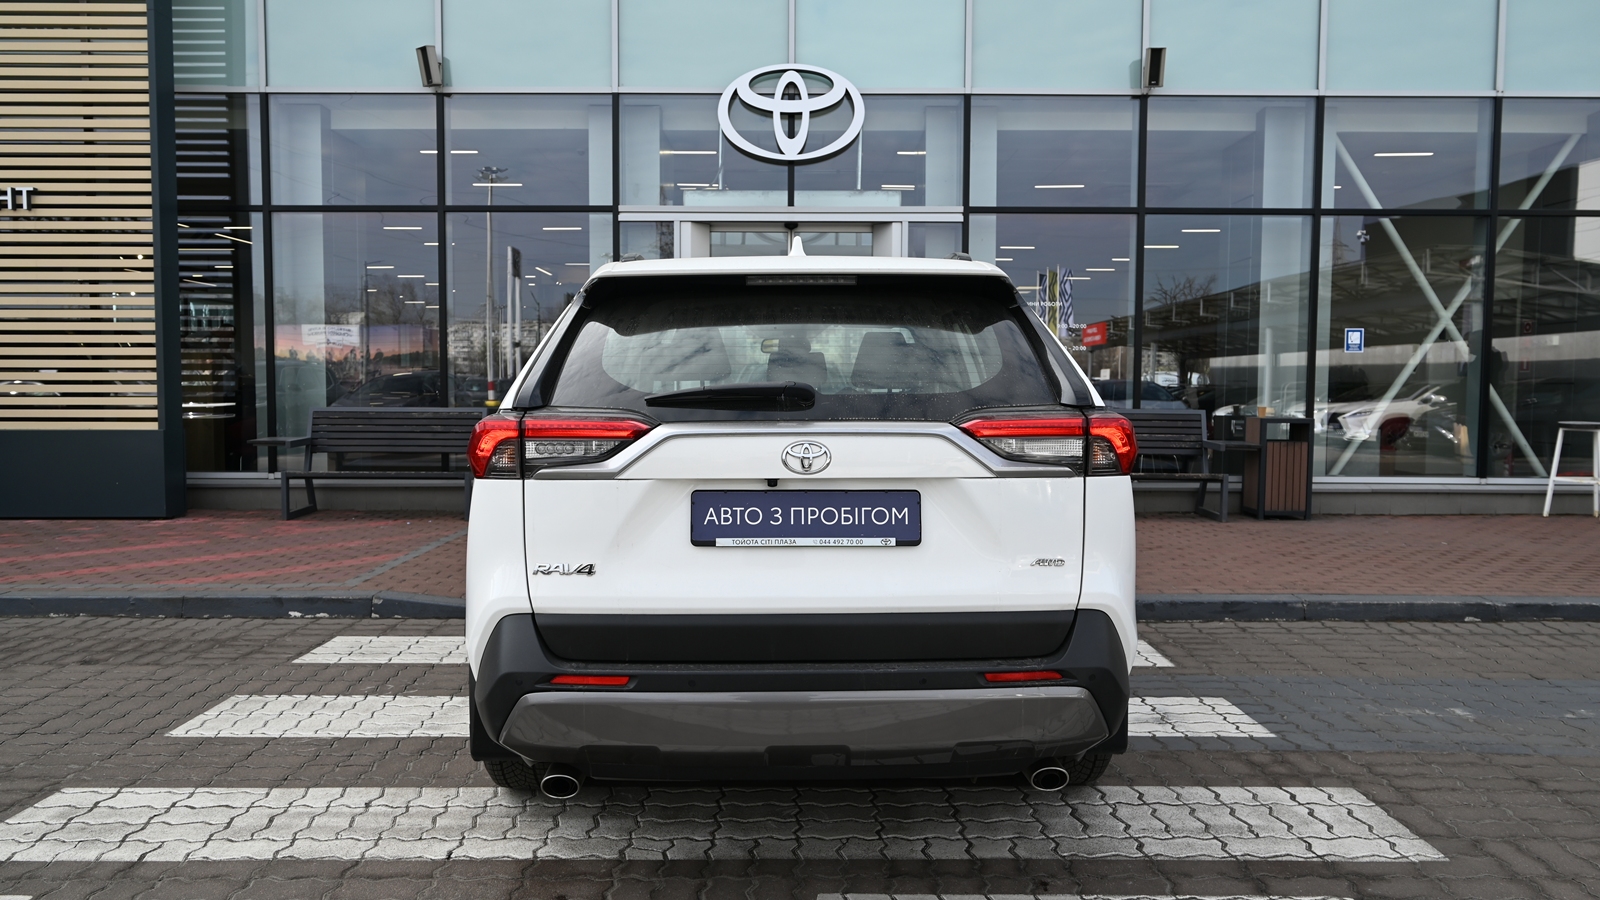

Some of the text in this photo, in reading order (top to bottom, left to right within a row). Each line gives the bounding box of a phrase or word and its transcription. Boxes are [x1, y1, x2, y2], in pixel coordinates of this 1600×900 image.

[703, 507, 909, 526] АВТО З ПРОБІГОМ
[1030, 558, 1065, 567] AWD
[532, 563, 596, 577] RAV4
